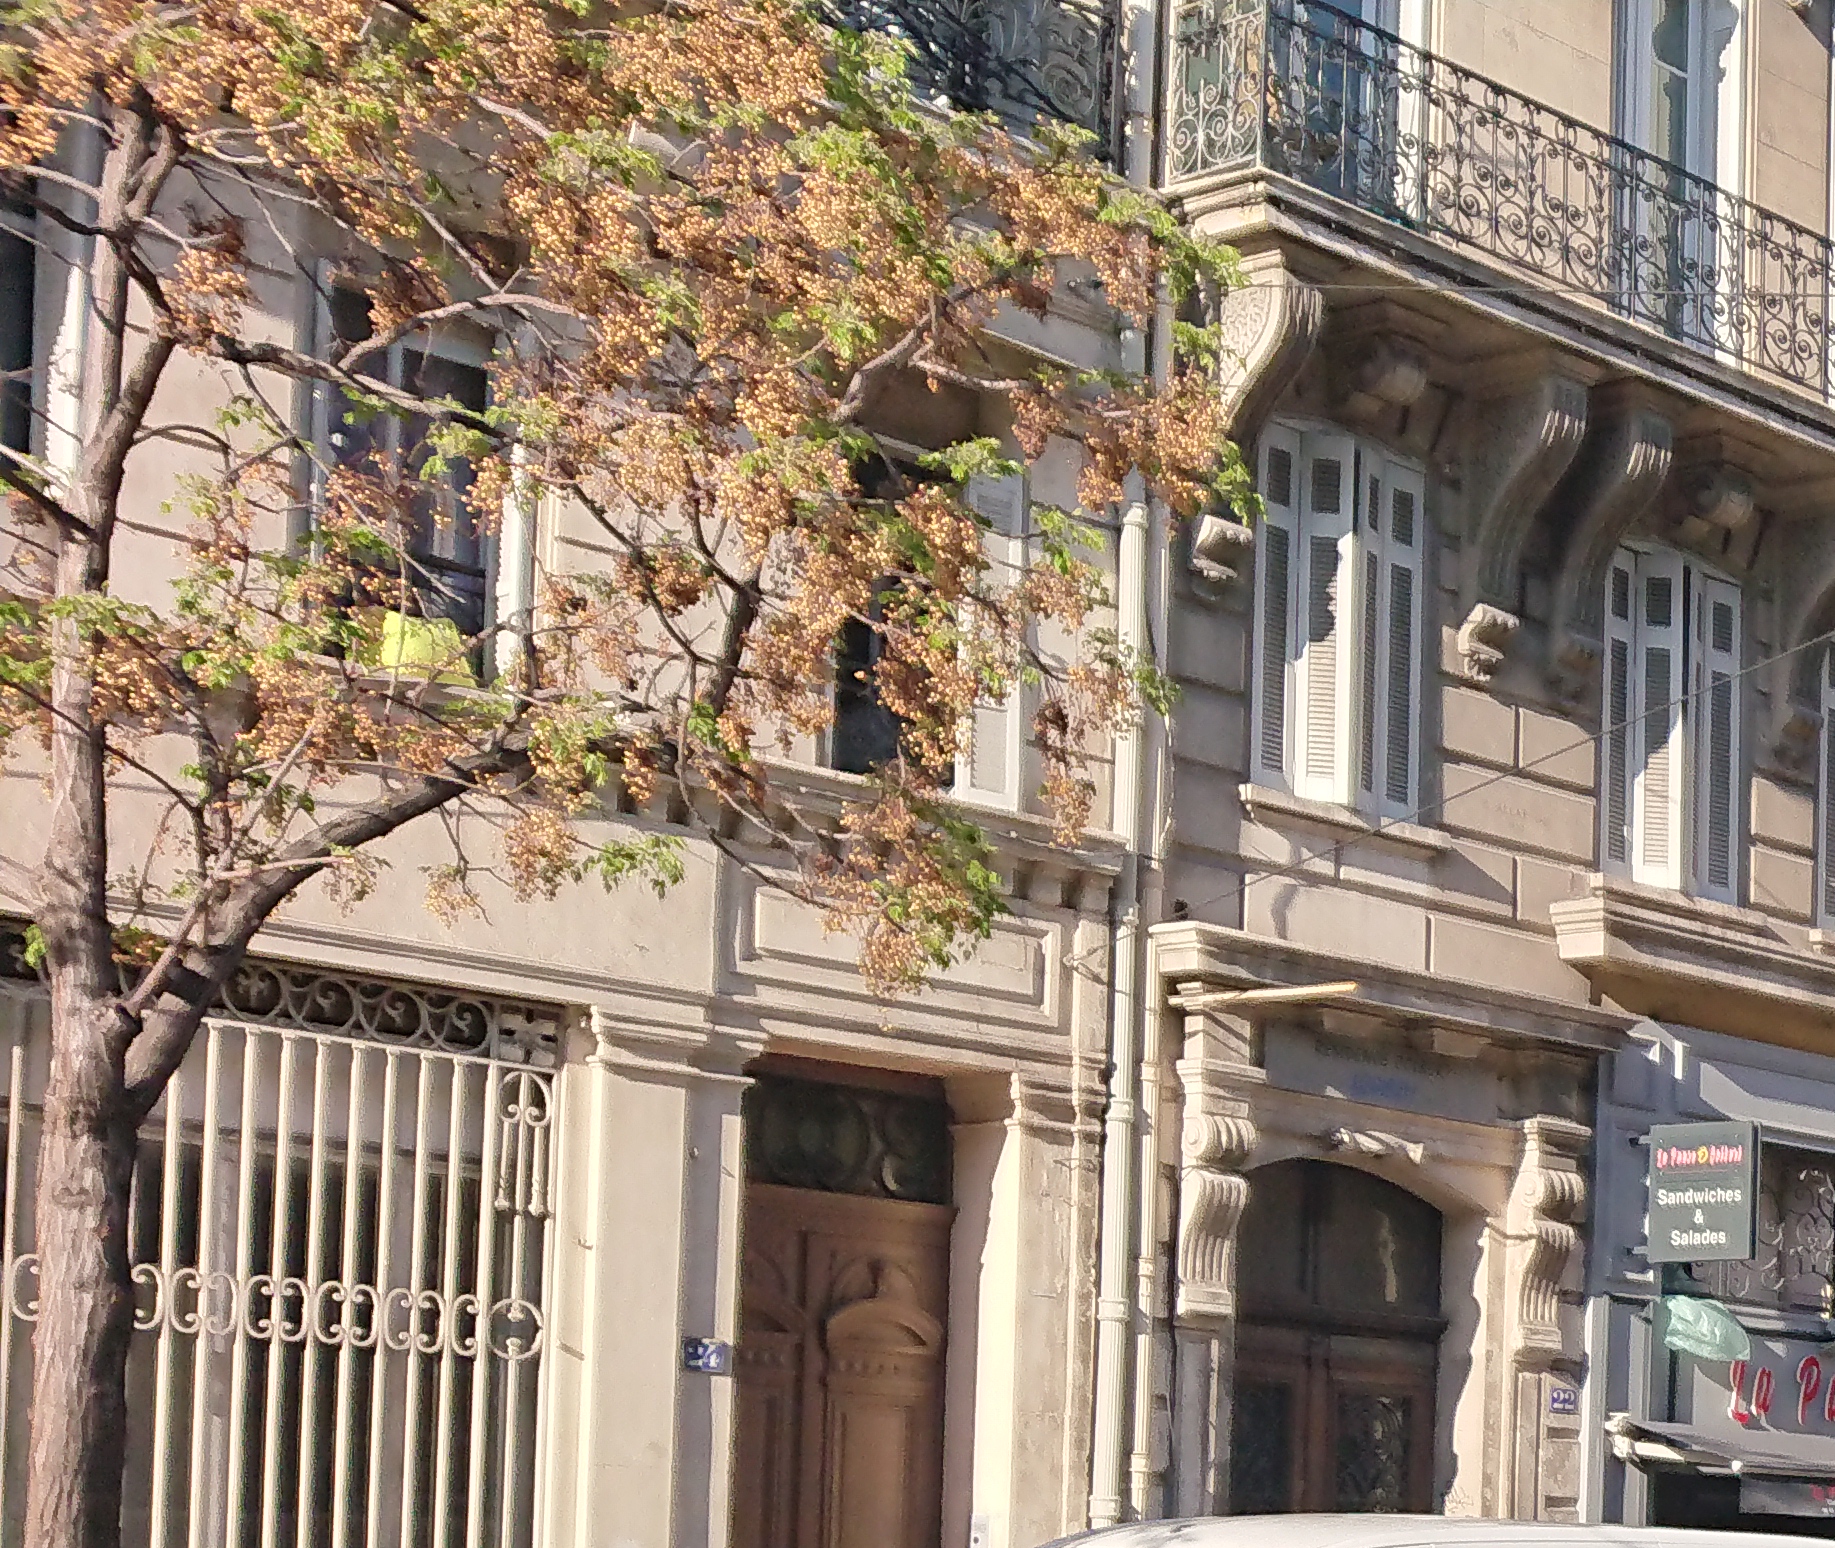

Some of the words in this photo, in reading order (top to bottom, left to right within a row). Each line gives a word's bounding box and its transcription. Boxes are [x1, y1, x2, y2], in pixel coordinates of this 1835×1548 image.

[1656, 1187, 1742, 1206] Sandwiches
[1693, 1208, 1705, 1225] &
[1670, 1229, 1727, 1247] Salades
[1552, 1389, 1576, 1410] 22
[1727, 1359, 1776, 1425] La
